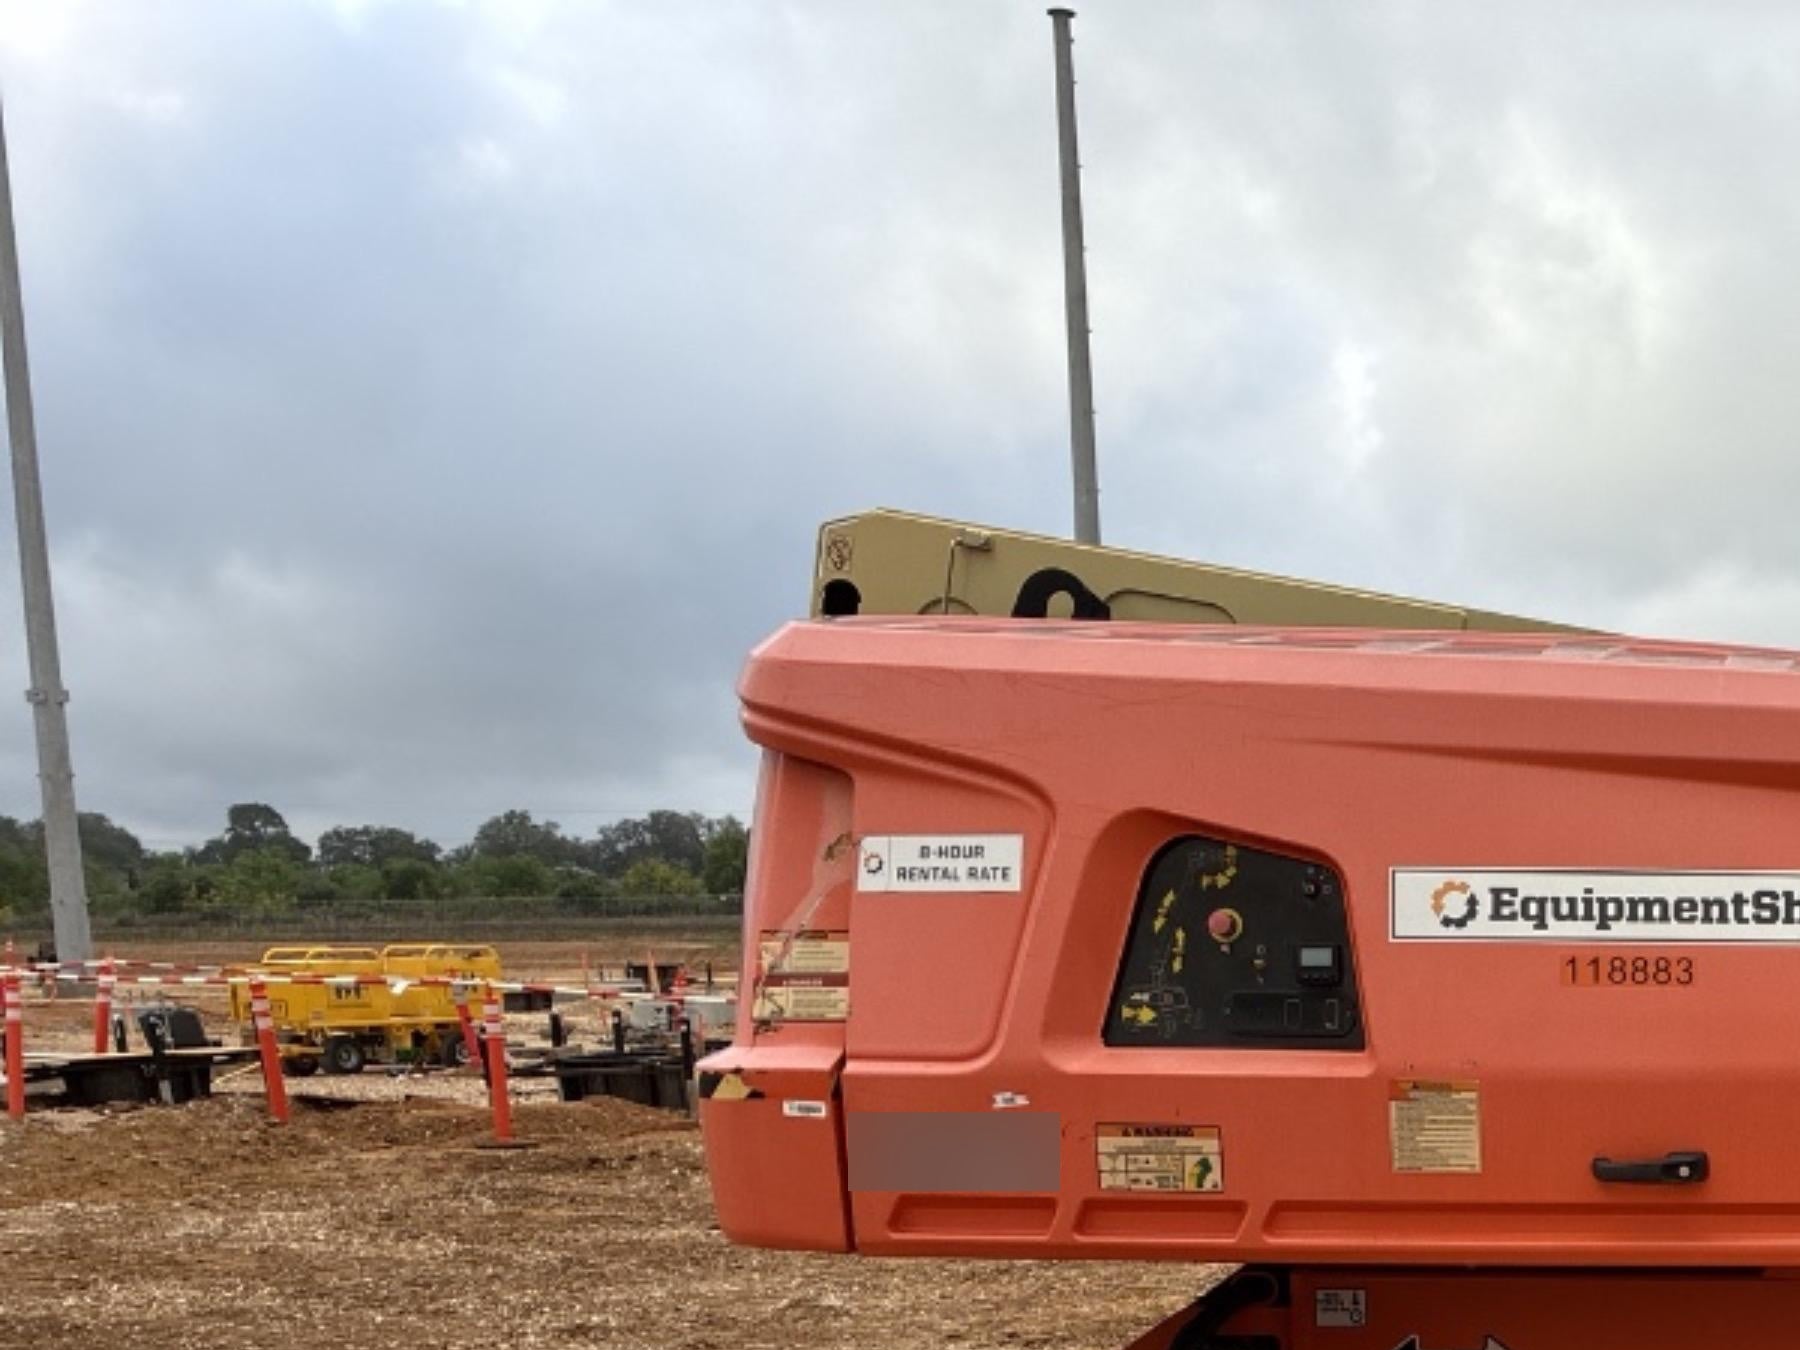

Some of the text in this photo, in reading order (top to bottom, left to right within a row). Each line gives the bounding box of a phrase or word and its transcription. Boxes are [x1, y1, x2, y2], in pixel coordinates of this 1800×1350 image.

[896, 866, 1011, 881] RENTAL RATE
[1565, 956, 1694, 985] 118883
